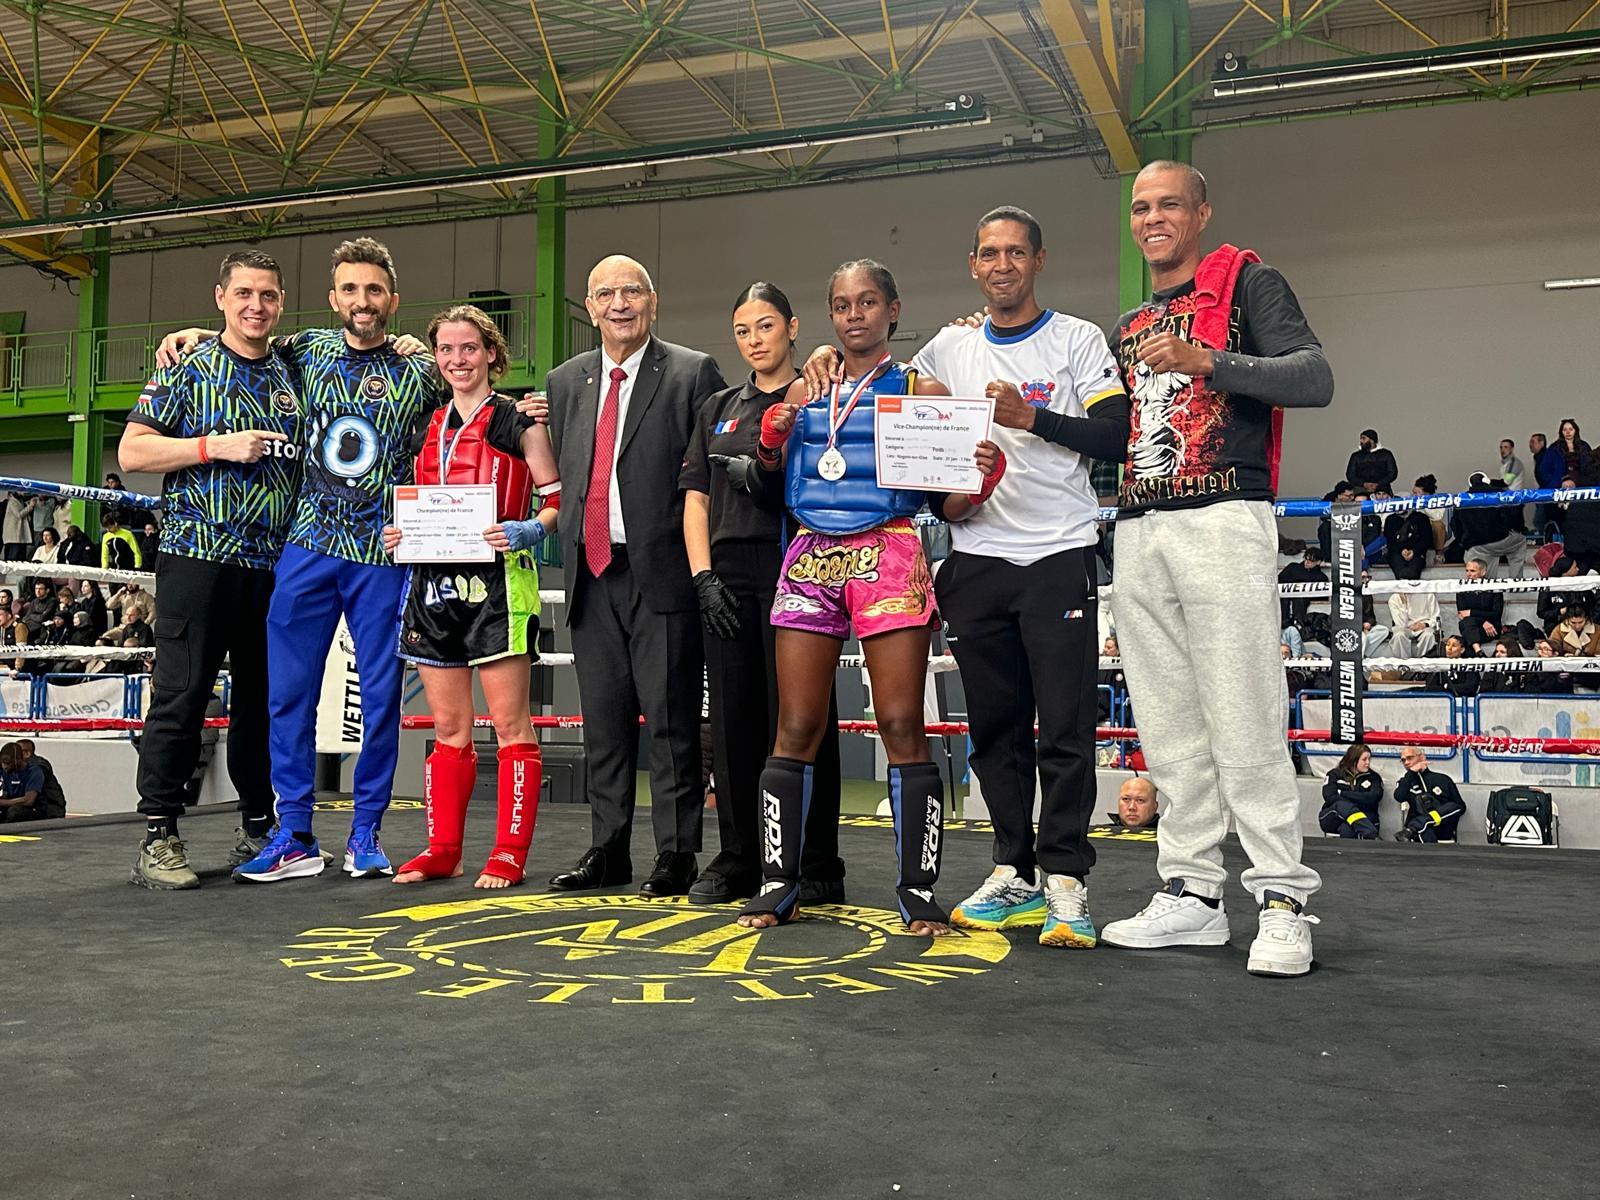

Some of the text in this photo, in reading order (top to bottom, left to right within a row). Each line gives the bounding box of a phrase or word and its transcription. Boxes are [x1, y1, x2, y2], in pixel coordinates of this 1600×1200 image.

[893, 423, 943, 432] Vice-Champion(ne)
[1374, 495, 1461, 513] WETTLE GEAR
[1553, 488, 1600, 502] WETTL
[1281, 582, 1330, 593] WETTLE
[1339, 539, 1355, 620] WETTLE GEAR
[1340, 661, 1355, 708] WETTLE
[1340, 709, 1355, 742] GEAR
[1508, 743, 1544, 754] GEAR
[767, 795, 783, 870] RDX
[921, 795, 934, 872] GIANT INSIDE
[925, 799, 942, 876] RDX
[280, 925, 992, 1004] WETTLE GEAR
